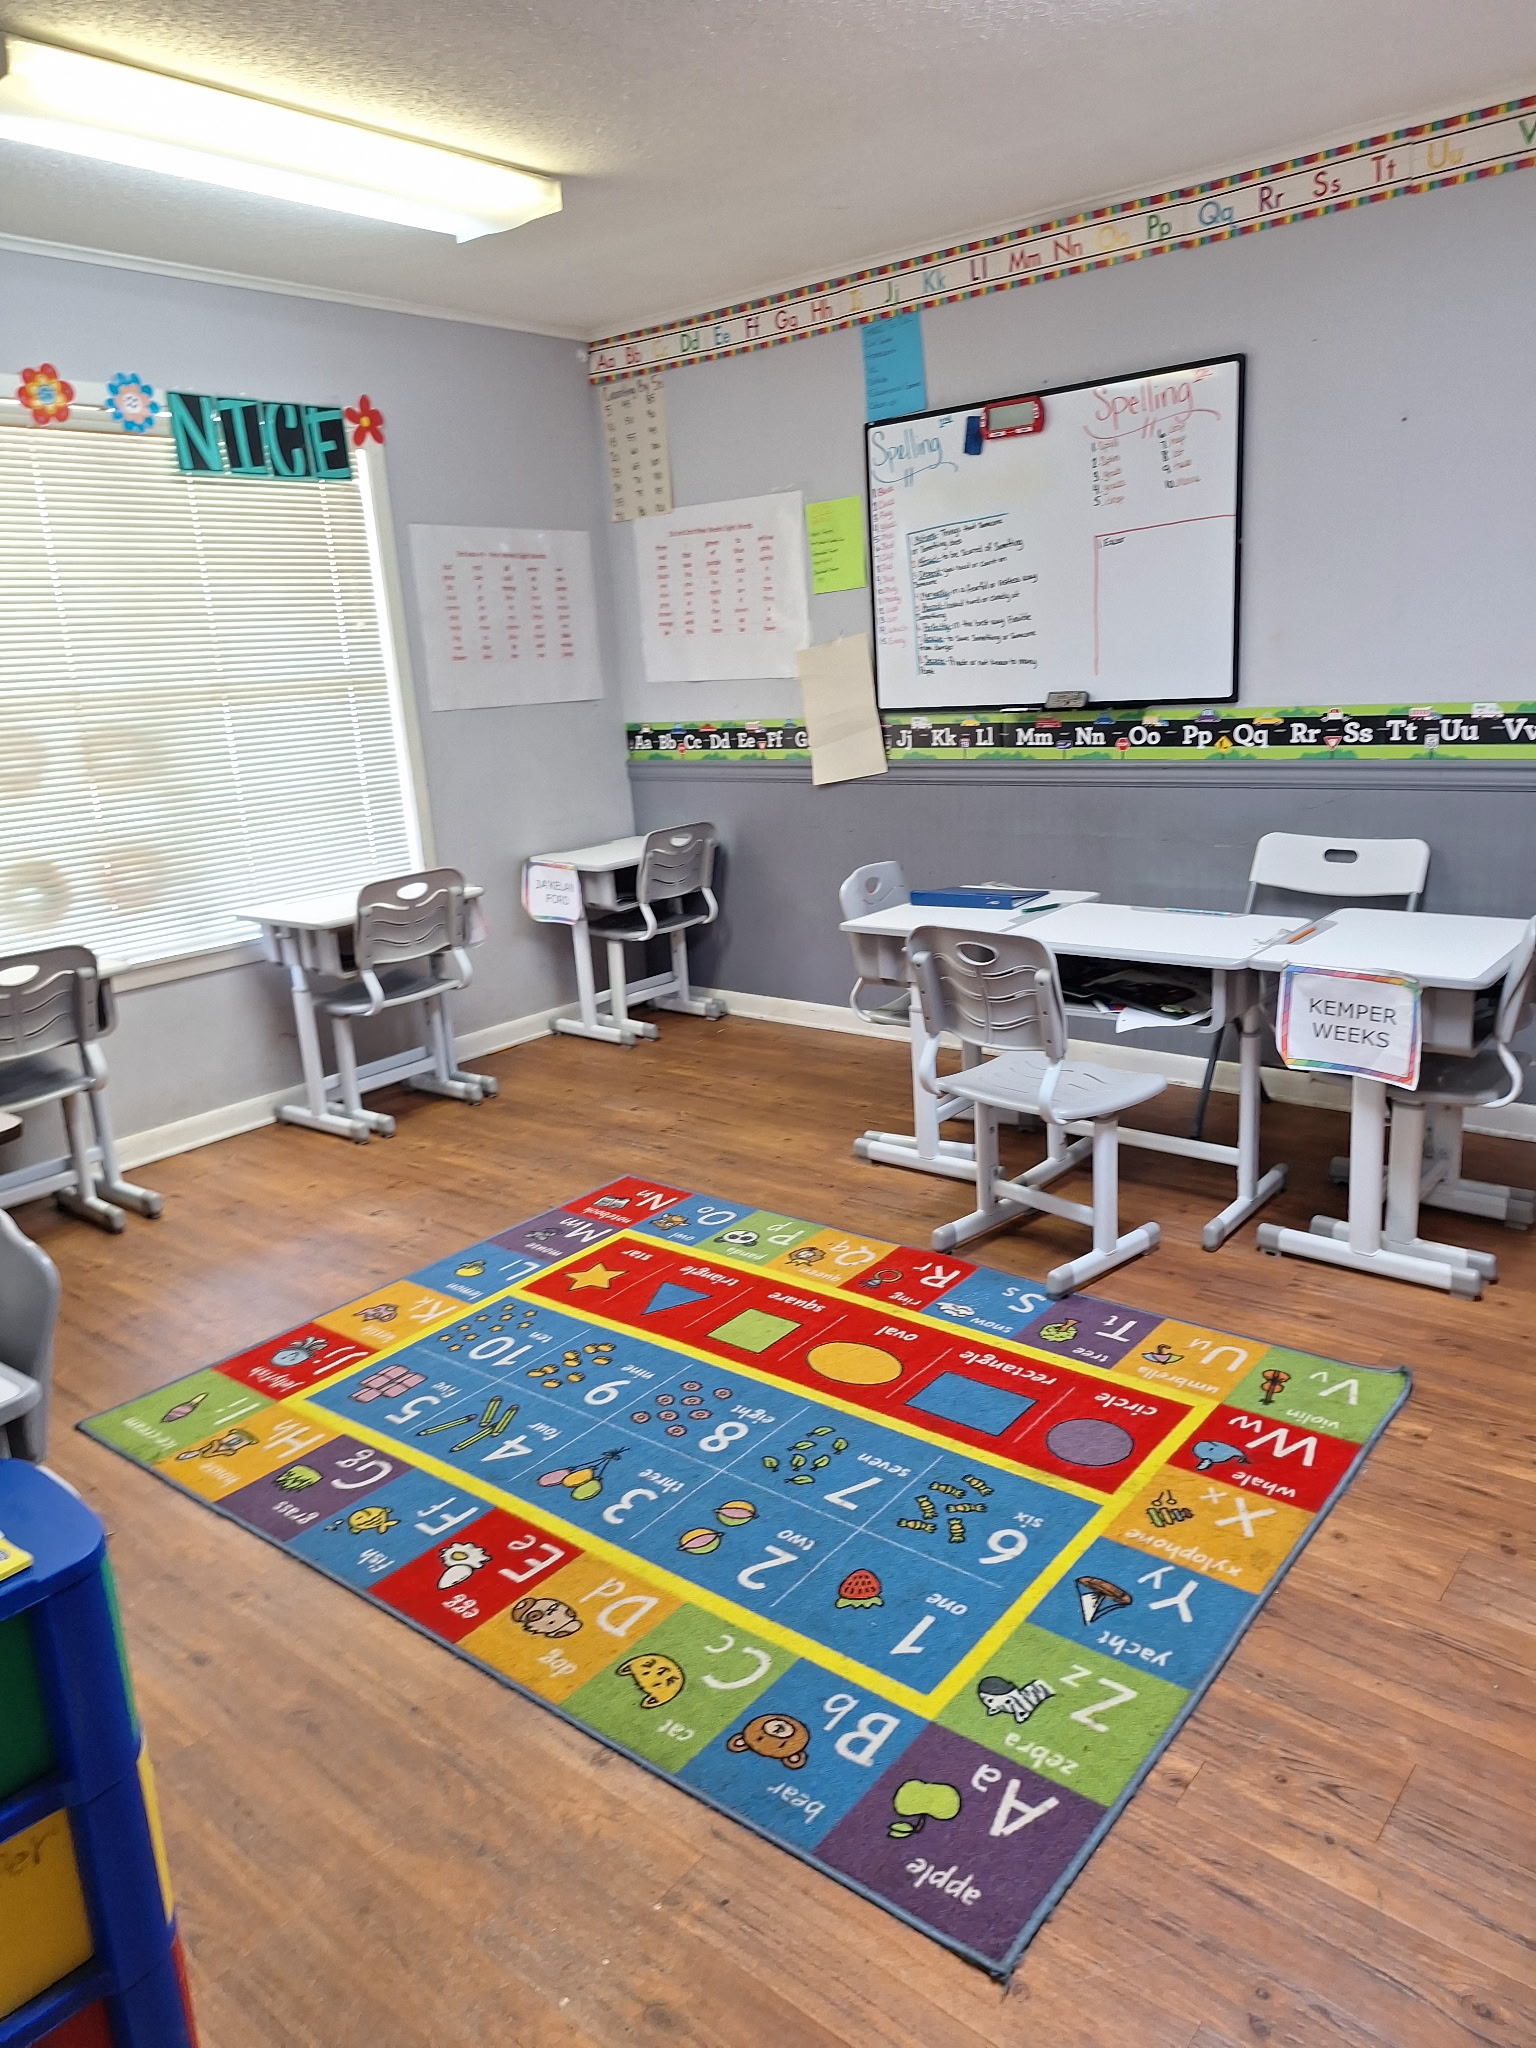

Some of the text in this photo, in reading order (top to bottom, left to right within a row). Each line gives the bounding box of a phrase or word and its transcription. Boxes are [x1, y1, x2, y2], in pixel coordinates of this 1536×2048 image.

[597, 352, 617, 369] Aa
[624, 347, 642, 364] Bb
[680, 333, 699, 353] Dd
[713, 327, 731, 347] Ee
[745, 318, 760, 338] Ff
[810, 302, 832, 324] Hh
[884, 282, 900, 306] Jj
[922, 270, 946, 293] Kk
[970, 258, 987, 282] Ll
[1008, 249, 1042, 274] Mm
[1053, 239, 1084, 262] Nn
[1147, 214, 1172, 242] Pp
[1197, 201, 1236, 229] Qq
[1258, 185, 1286, 212] Rr
[1312, 171, 1342, 198] Ss
[1371, 154, 1397, 183] Tt
[1426, 142, 1464, 169] Uu
[1092, 378, 1193, 430] Spelling
[168, 392, 351, 479] NICE
[872, 428, 943, 473] Spelling
[634, 735, 653, 750] Aa
[658, 733, 676, 750] Bb
[683, 734, 703, 750] Cc
[709, 733, 730, 750] Dd
[737, 732, 756, 749] Ee
[766, 731, 784, 748] Ff
[895, 729, 913, 751] Jj
[931, 728, 957, 747] Kk
[975, 727, 994, 747] Ll
[1016, 727, 1055, 746] Mm
[1075, 726, 1107, 746] Nn
[1128, 725, 1161, 746] Oo
[1182, 725, 1213, 750] Pp
[1233, 724, 1270, 749] Qq
[1290, 722, 1321, 744] Rr
[1342, 721, 1374, 743] Ss
[1386, 720, 1418, 742] Tt
[1440, 718, 1480, 742] Uu
[1309, 997, 1398, 1026] KEMPER
[1312, 1022, 1391, 1049] WEEKS
[634, 1189, 678, 1211] Nn
[581, 1206, 633, 1224] notebook
[697, 1206, 737, 1226] Oo
[559, 1216, 613, 1243] Mm
[667, 1231, 696, 1241] owl
[766, 1221, 805, 1246] Pp
[524, 1242, 564, 1257] mouse
[620, 1249, 654, 1262] star
[725, 1247, 768, 1261] panda
[828, 1240, 876, 1267] Qq
[498, 1258, 541, 1281] Ll
[679, 1265, 739, 1287] triangle
[799, 1266, 842, 1283] queen
[912, 1262, 961, 1289] Rr
[445, 1283, 484, 1300] lemon
[767, 1291, 826, 1313] square
[888, 1291, 922, 1307] ring
[1001, 1286, 1047, 1313] Ss
[409, 1296, 458, 1324] Kk
[528, 1331, 554, 1344] ten
[873, 1325, 919, 1341] oval
[970, 1317, 1014, 1334] snow
[1094, 1315, 1137, 1343] Tt
[313, 1345, 368, 1375] Jj
[467, 1336, 534, 1367] 10
[1072, 1346, 1109, 1363] tree
[1187, 1338, 1248, 1372] Uu
[248, 1366, 306, 1393] jellyfish
[620, 1363, 656, 1380] nine
[958, 1350, 1057, 1386] rectangle
[1137, 1365, 1221, 1395] umbrella
[431, 1381, 462, 1398] five
[583, 1380, 631, 1406] 9
[1309, 1371, 1359, 1405] Vv
[214, 1397, 261, 1426] Ii
[384, 1395, 441, 1425] 5
[730, 1404, 776, 1425] eight
[1094, 1392, 1159, 1416] circle
[527, 1422, 562, 1442] four
[1285, 1408, 1341, 1431] violin
[263, 1419, 325, 1460] Hh
[481, 1434, 534, 1462] 4
[698, 1421, 749, 1452] 8
[1228, 1415, 1318, 1467] Ww
[330, 1448, 393, 1489] Gg
[857, 1451, 912, 1478] seven
[637, 1468, 687, 1494] three
[822, 1476, 884, 1511] 7
[1231, 1471, 1296, 1499] whale
[271, 1500, 320, 1525] grass
[414, 1497, 480, 1536] Ff
[602, 1488, 658, 1525] 3
[1013, 1511, 1044, 1529] six
[1200, 1487, 1277, 1538] Xx
[775, 1528, 816, 1551] two
[978, 1528, 1029, 1565] 6
[1124, 1528, 1243, 1577] xylophone
[357, 1548, 396, 1574] fish
[498, 1534, 565, 1583] Ee
[736, 1544, 799, 1590] 2
[442, 1593, 480, 1620] egg
[579, 1577, 660, 1637] Dd
[925, 1592, 969, 1617] one
[1137, 1565, 1199, 1623] Yy
[889, 1614, 936, 1655] 1
[1096, 1630, 1173, 1667] yacht
[537, 1648, 578, 1679] dog
[701, 1634, 772, 1690] Cc
[1059, 1663, 1139, 1732] Zz
[656, 1718, 695, 1742] cat
[822, 1693, 902, 1768] Bb
[1003, 1731, 1080, 1776] zebra
[765, 1780, 827, 1825] bear
[970, 1763, 1060, 1837] Aa
[904, 1856, 982, 1906] apple
